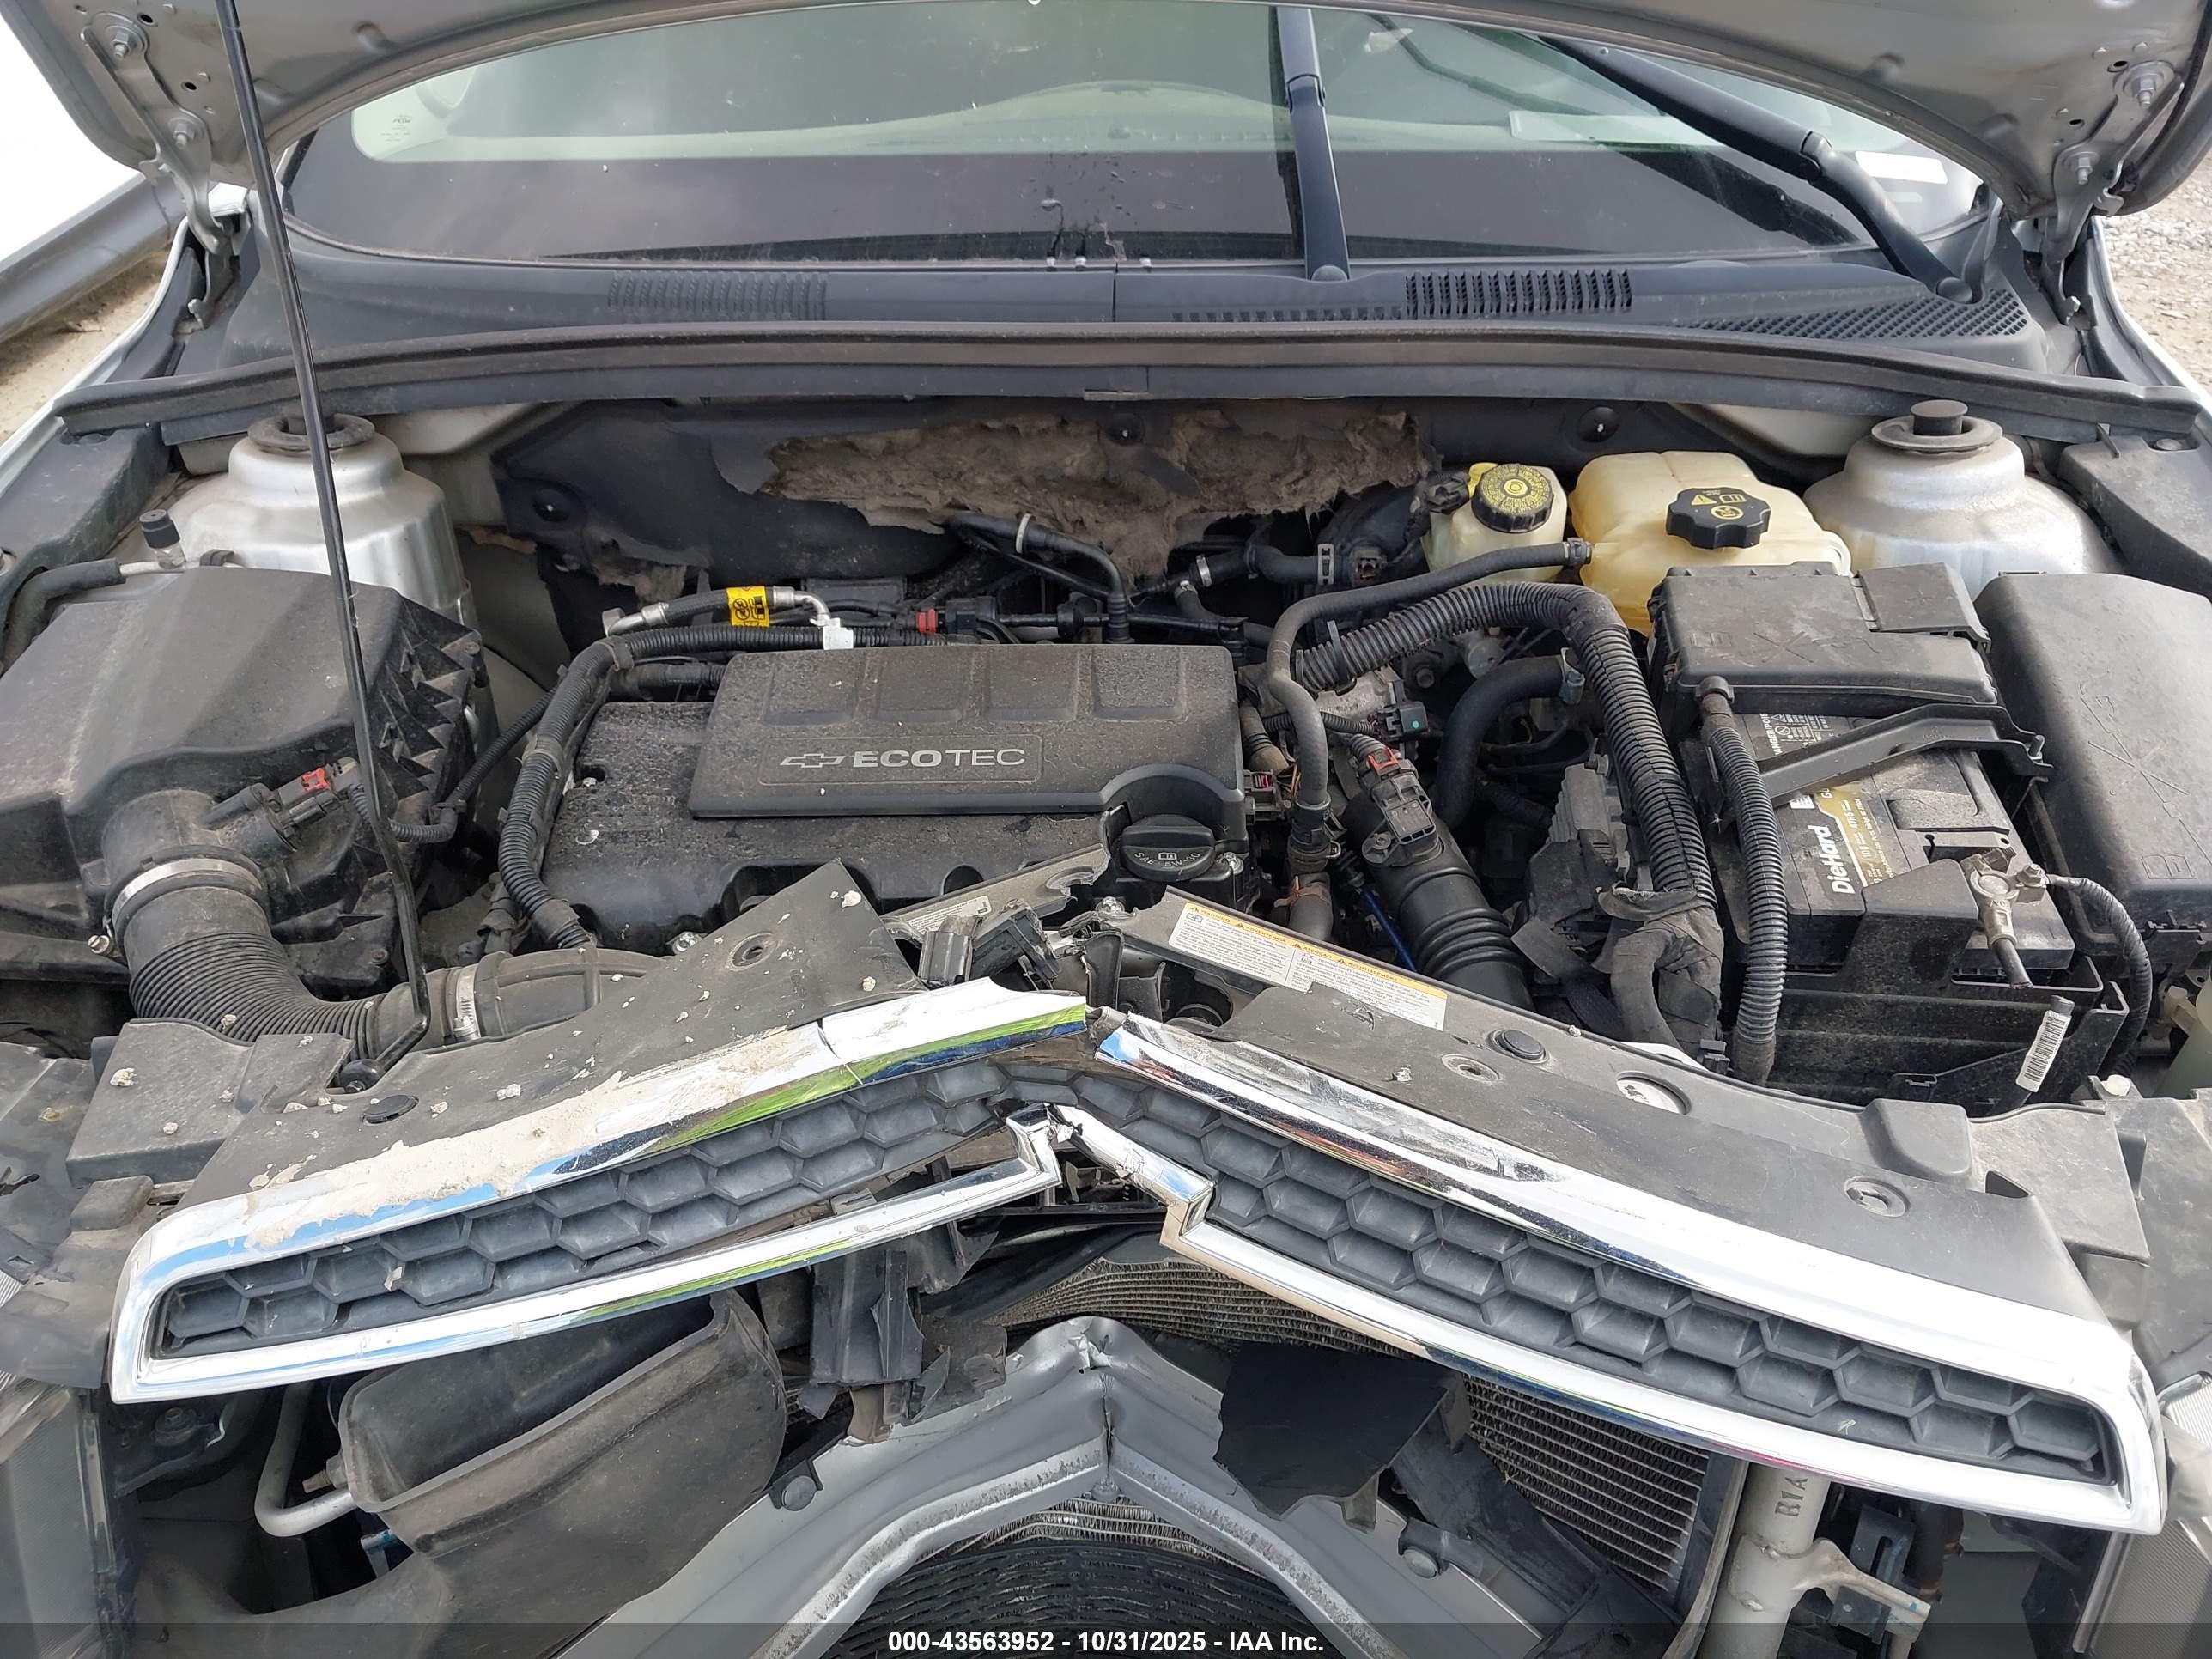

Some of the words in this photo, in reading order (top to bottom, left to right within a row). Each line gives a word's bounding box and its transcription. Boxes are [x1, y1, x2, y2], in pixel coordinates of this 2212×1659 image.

[853, 749, 1026, 768] ECOTEC
[1134, 852, 1157, 865] SAE
[1808, 824, 1856, 894] DieHard
